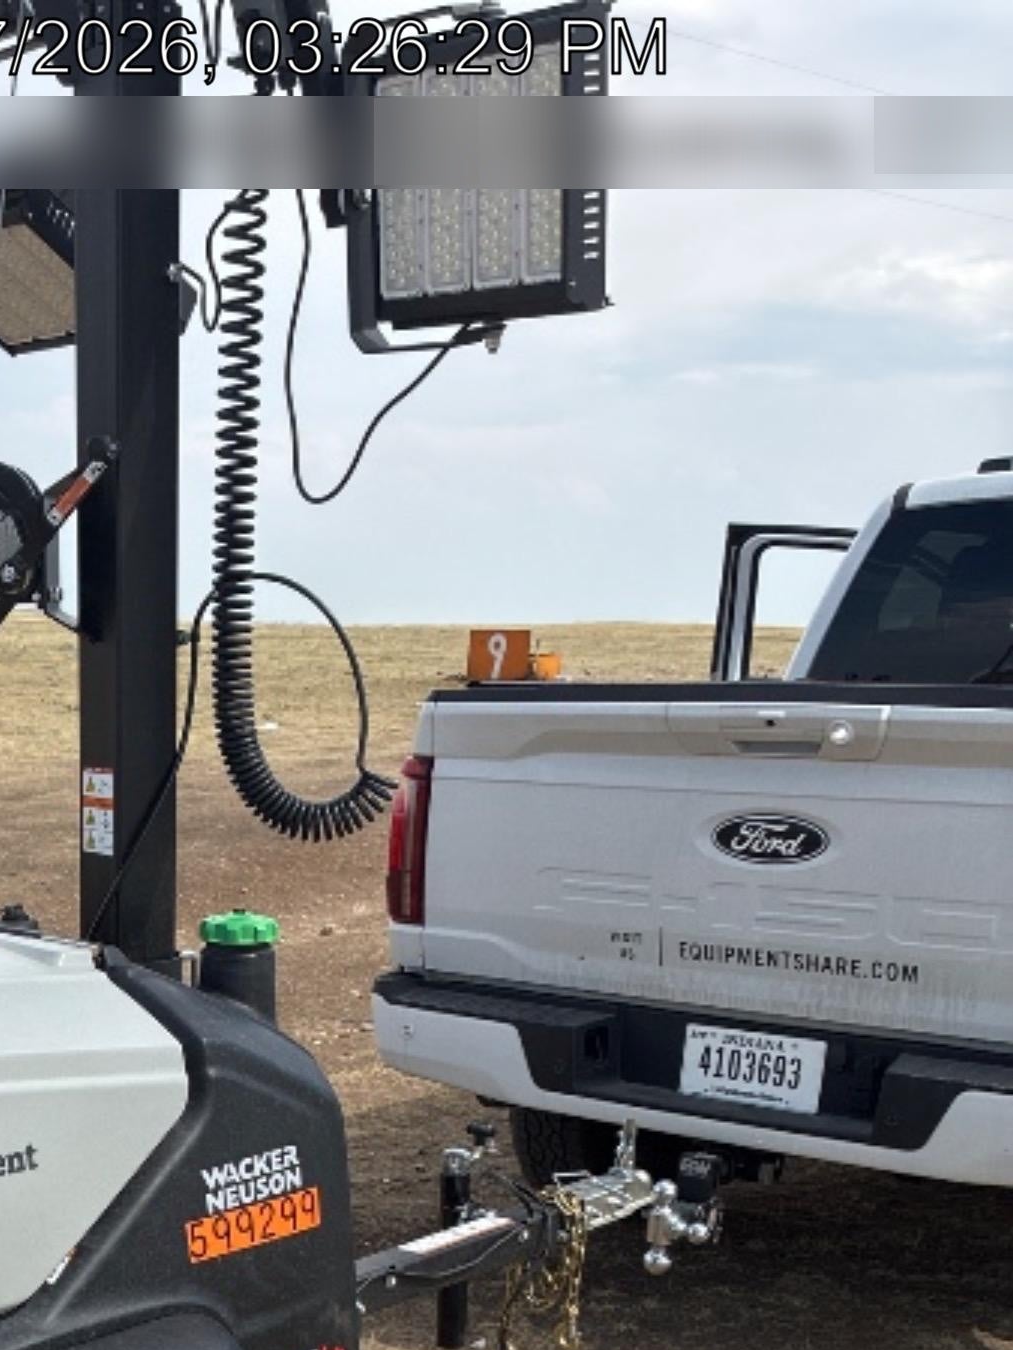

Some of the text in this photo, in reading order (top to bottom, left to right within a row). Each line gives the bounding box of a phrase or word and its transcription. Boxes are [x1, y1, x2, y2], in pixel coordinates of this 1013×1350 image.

[488, 633, 508, 680] 9
[730, 821, 807, 856] Ford
[678, 940, 919, 984] EQUIPMENTSHARE.COM
[698, 1044, 802, 1090] 4103693
[200, 1144, 301, 1189] WACKER
[204, 1166, 304, 1216] NEUSON
[188, 1189, 317, 1260] 599299
